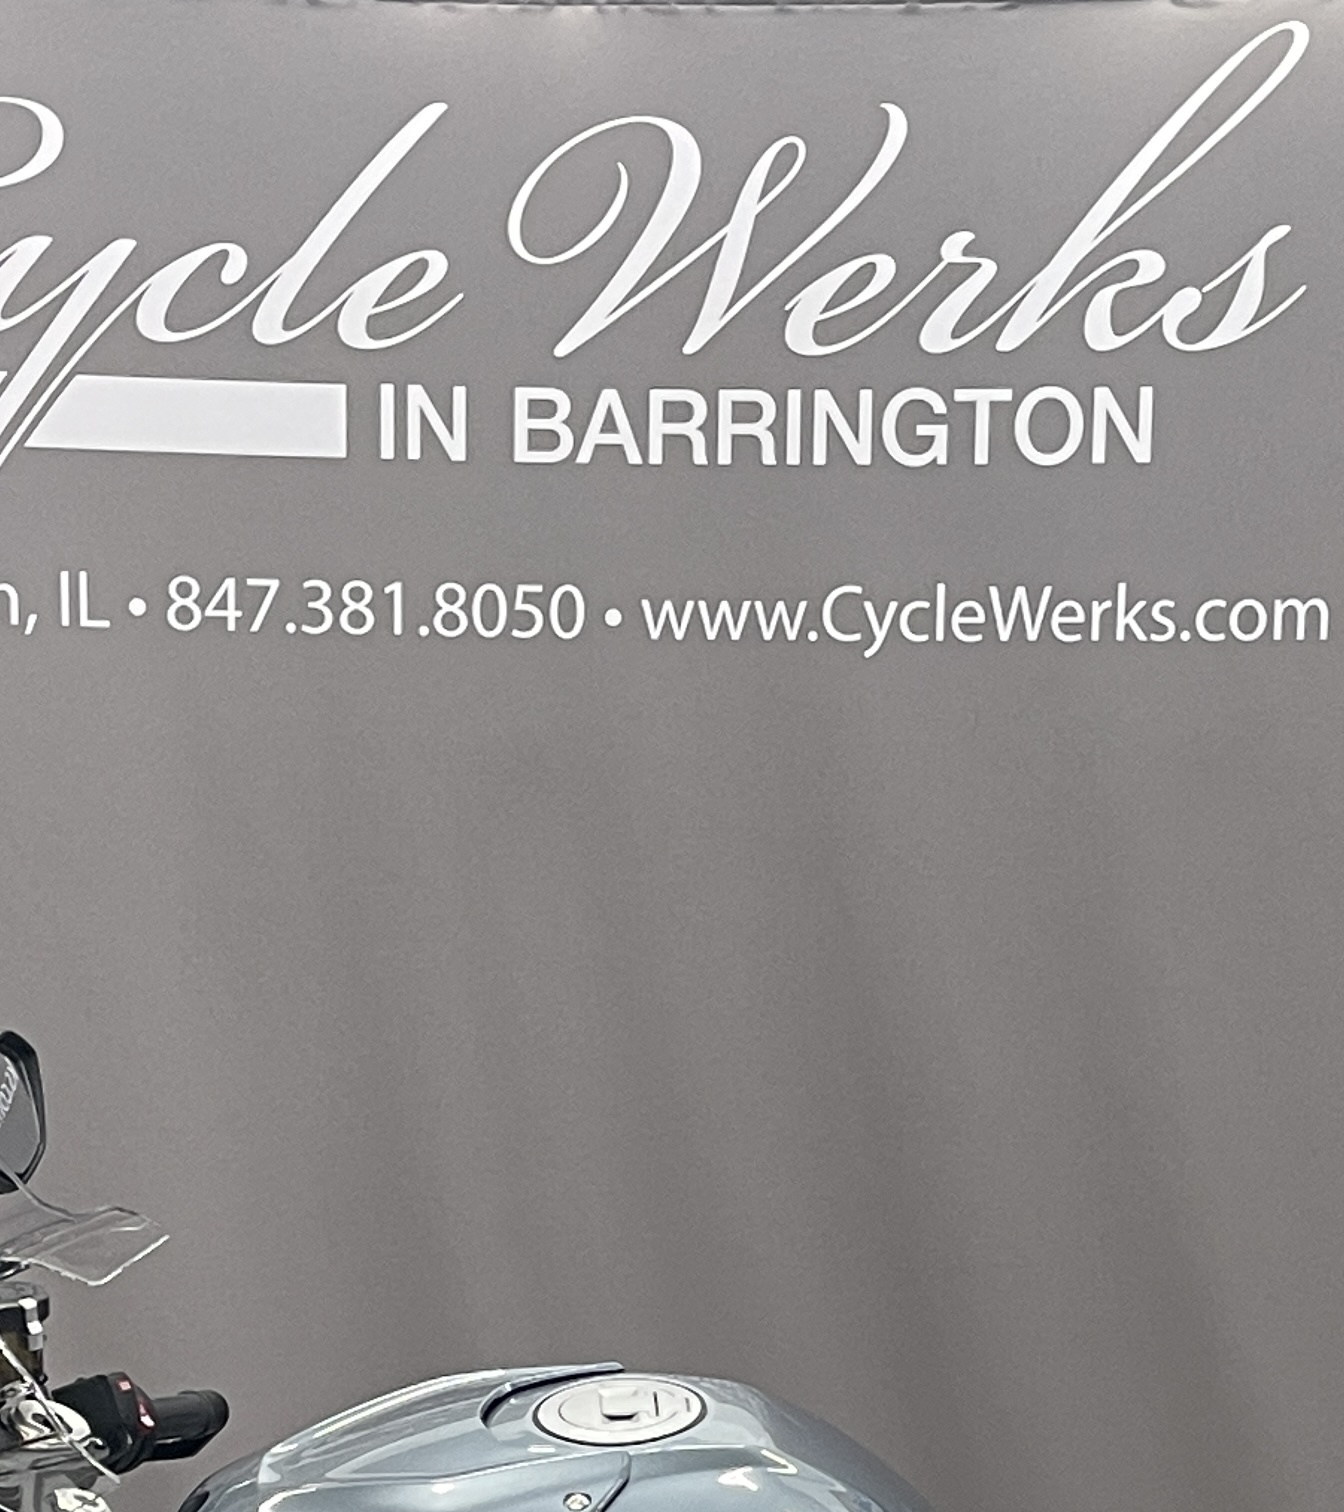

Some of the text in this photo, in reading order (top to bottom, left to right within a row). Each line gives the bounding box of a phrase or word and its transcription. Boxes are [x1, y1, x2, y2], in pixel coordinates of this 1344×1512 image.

[508, 20, 1310, 357] Werks
[380, 382, 1154, 468] IN BARRINGTON
[59, 570, 111, 630] IL
[166, 575, 585, 640] 847.381.8050
[641, 583, 1330, 659] www.CycleWerks.com
